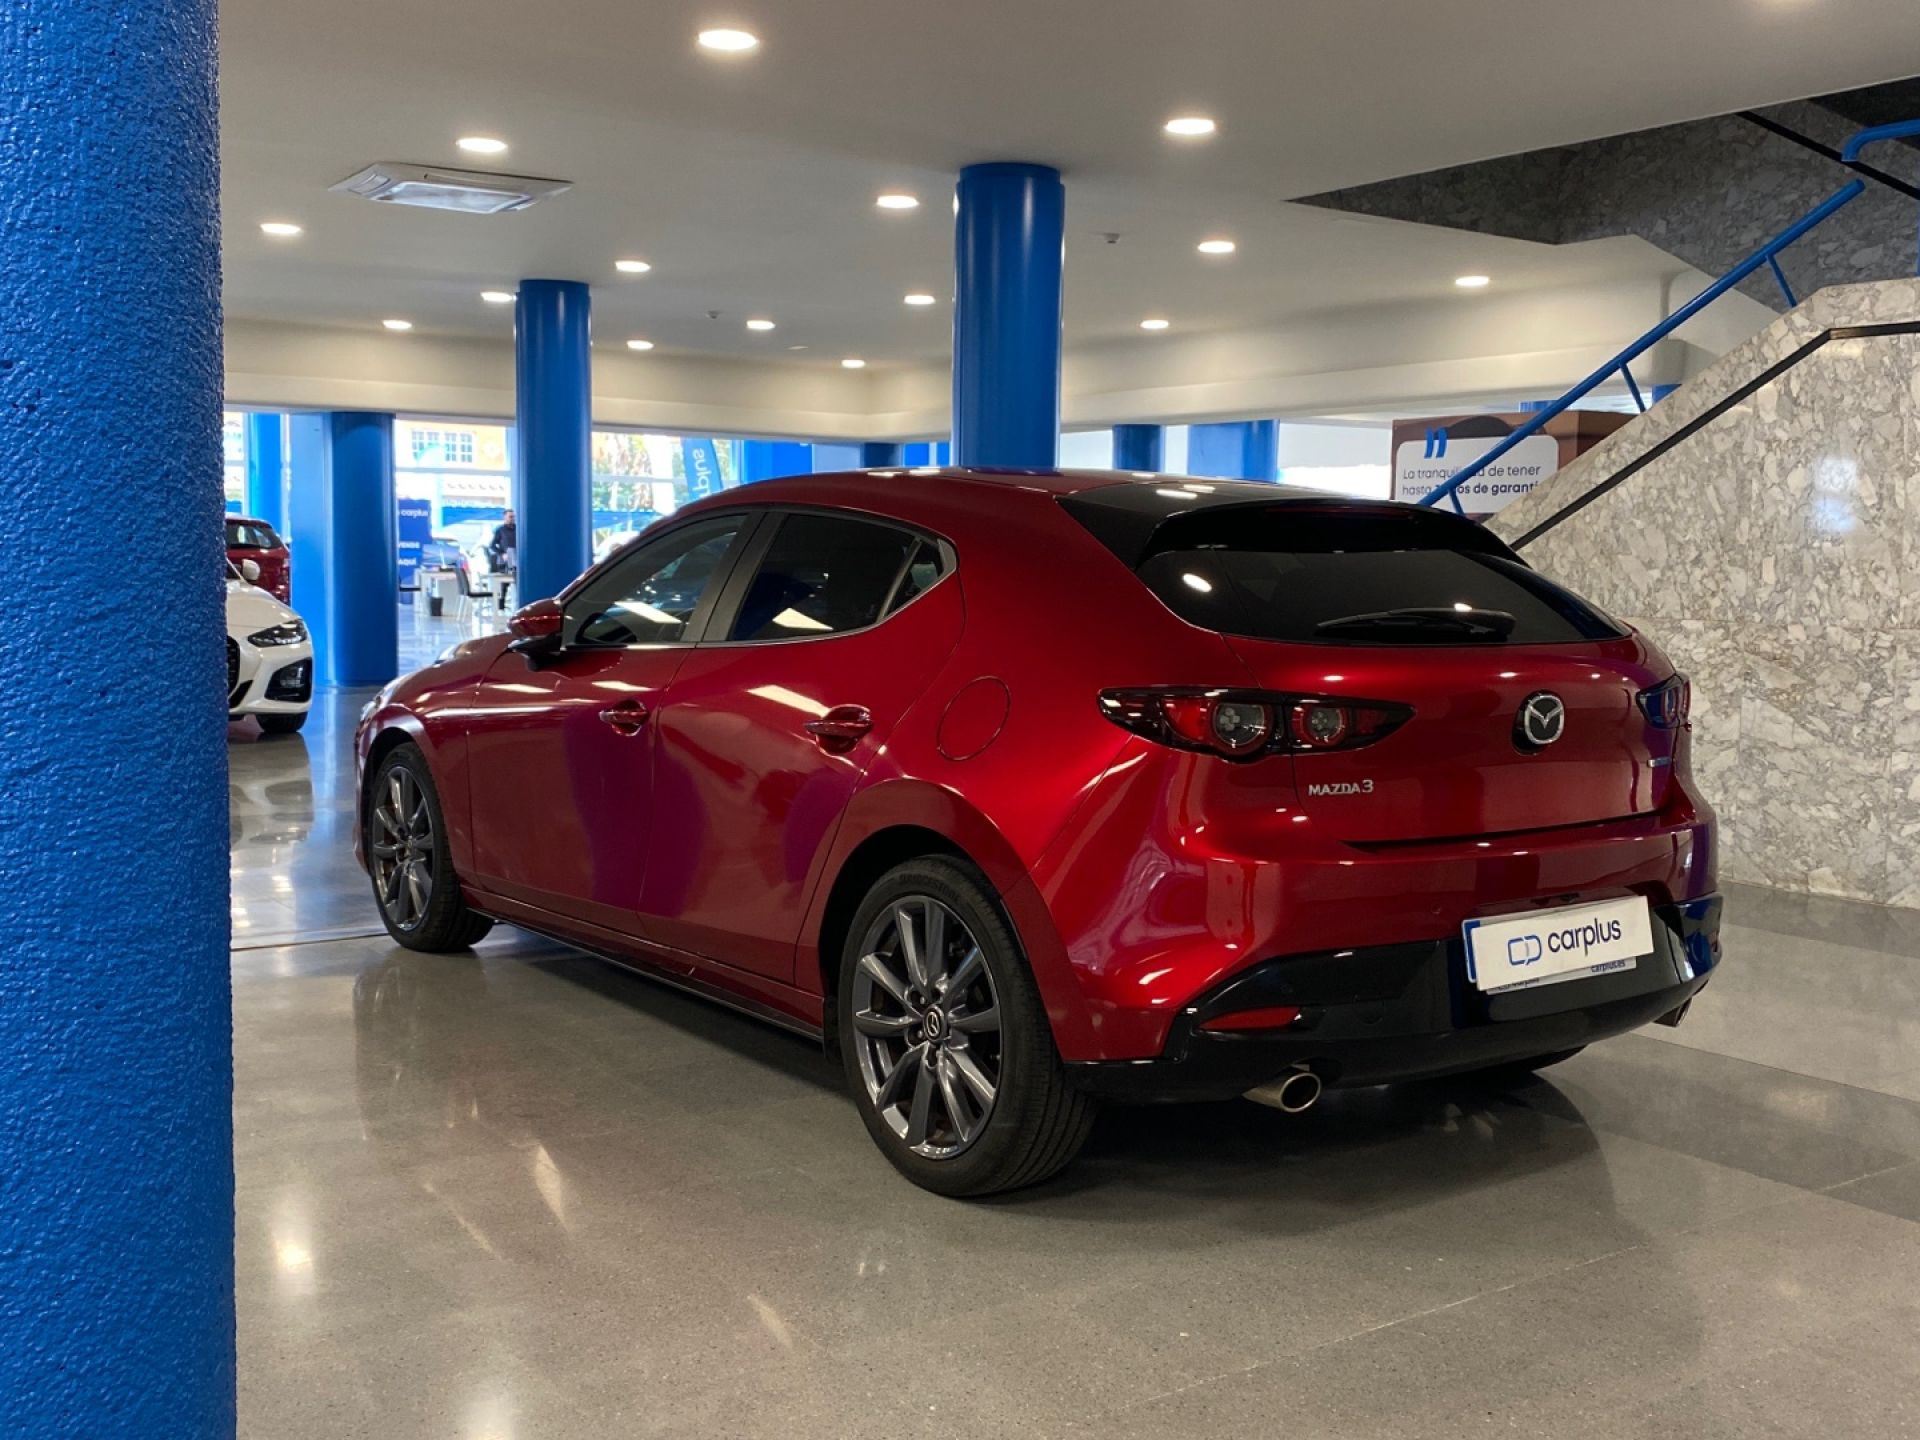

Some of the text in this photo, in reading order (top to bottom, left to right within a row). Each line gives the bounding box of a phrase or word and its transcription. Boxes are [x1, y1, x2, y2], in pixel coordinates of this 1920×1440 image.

[1403, 468, 1415, 480] La
[1488, 465, 1504, 477] de
[1507, 465, 1541, 477] tener
[1473, 482, 1489, 494] de
[1491, 480, 1538, 496] garant
[1547, 917, 1621, 957] carplus
